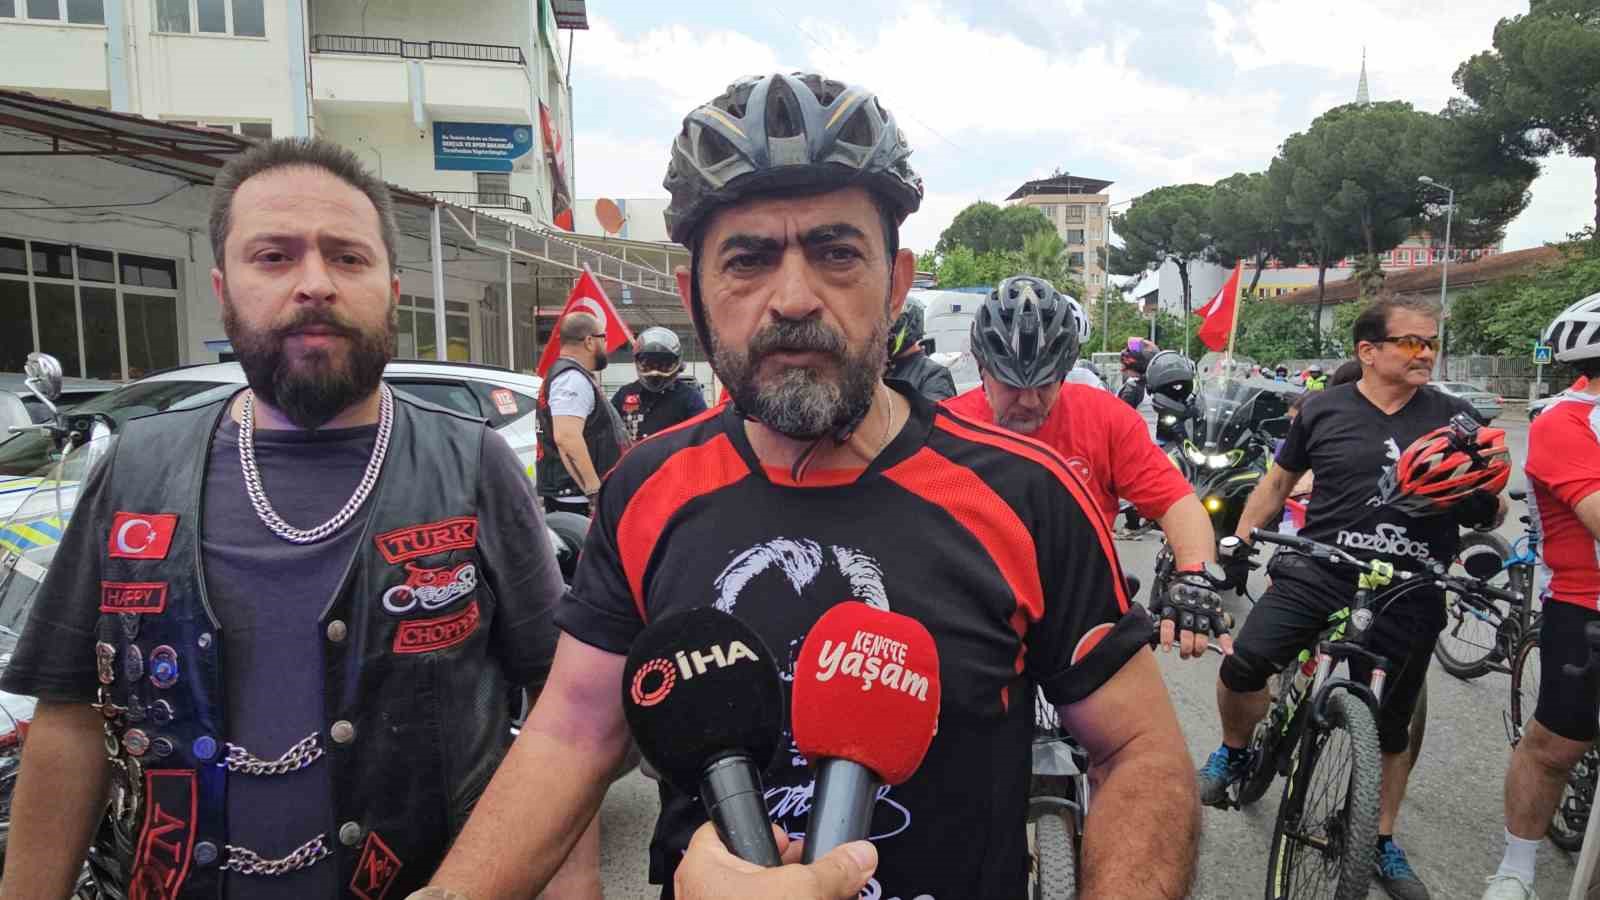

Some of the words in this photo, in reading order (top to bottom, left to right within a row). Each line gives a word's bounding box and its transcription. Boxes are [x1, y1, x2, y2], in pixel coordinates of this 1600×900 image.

[106, 590, 153, 606] HAPPY
[675, 639, 760, 681] İHA
[851, 630, 909, 666] KENTTE
